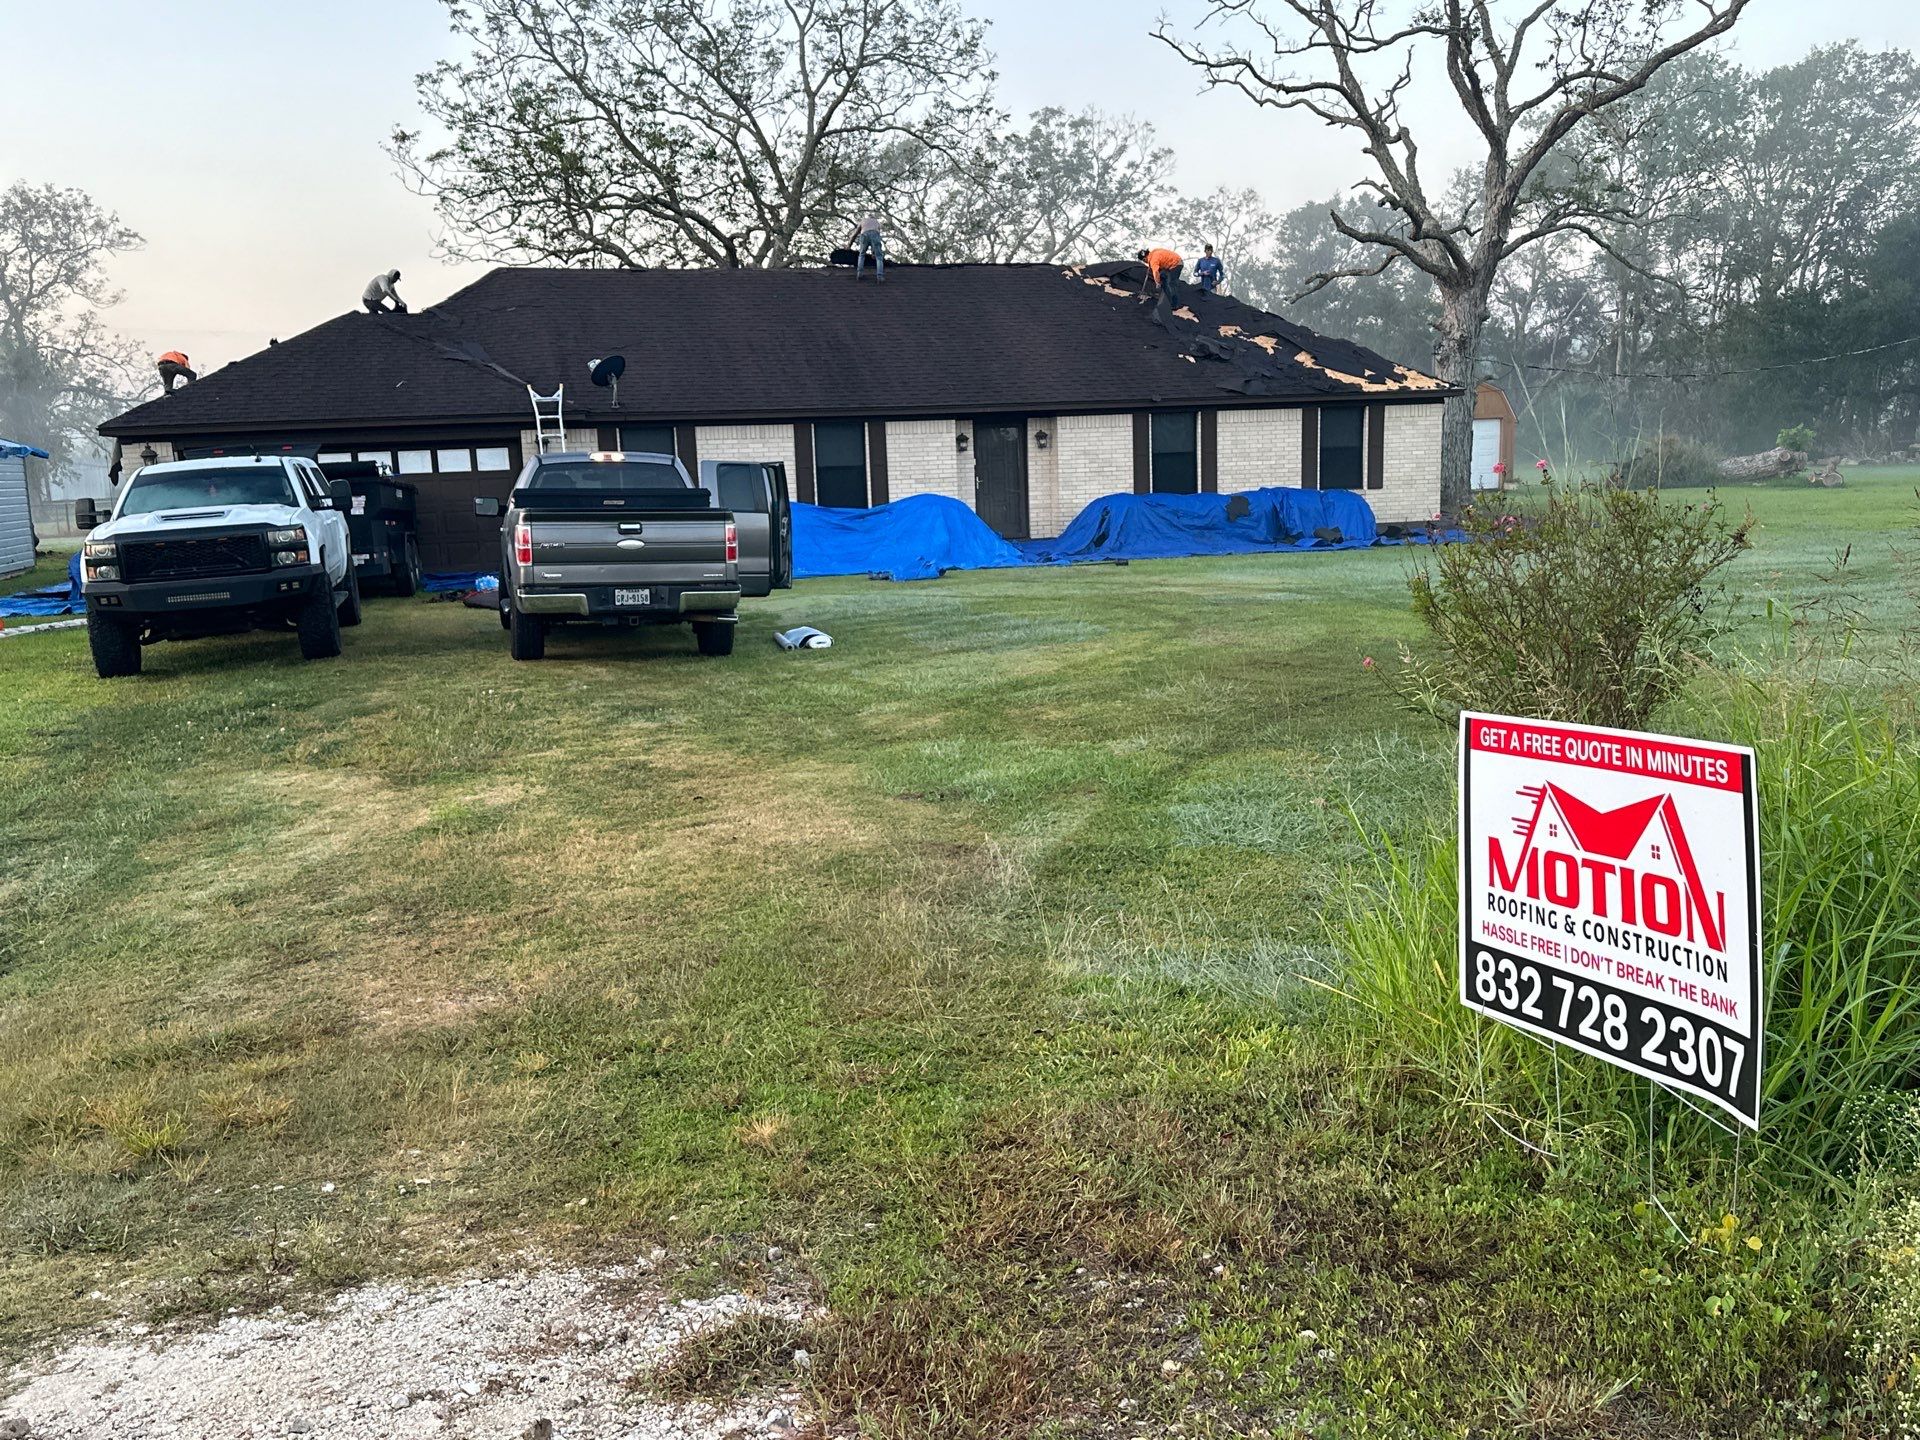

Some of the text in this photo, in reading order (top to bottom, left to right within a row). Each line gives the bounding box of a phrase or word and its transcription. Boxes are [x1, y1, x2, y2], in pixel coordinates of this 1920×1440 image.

[1480, 727, 1728, 784] GET A FREE QUOTE IN MINUTES
[1488, 830, 1727, 954] MOTION
[1488, 892, 1728, 983] ROOFING & CONSTRUCTION
[1482, 920, 1528, 948] HASSLE
[1531, 935, 1561, 959] FREE
[1571, 948, 1613, 974] DON'T
[1617, 961, 1666, 992] BREAK
[1668, 977, 1697, 1002] THE
[1701, 991, 1738, 1019] BANK
[1475, 950, 1745, 1098] 832 728 2307
